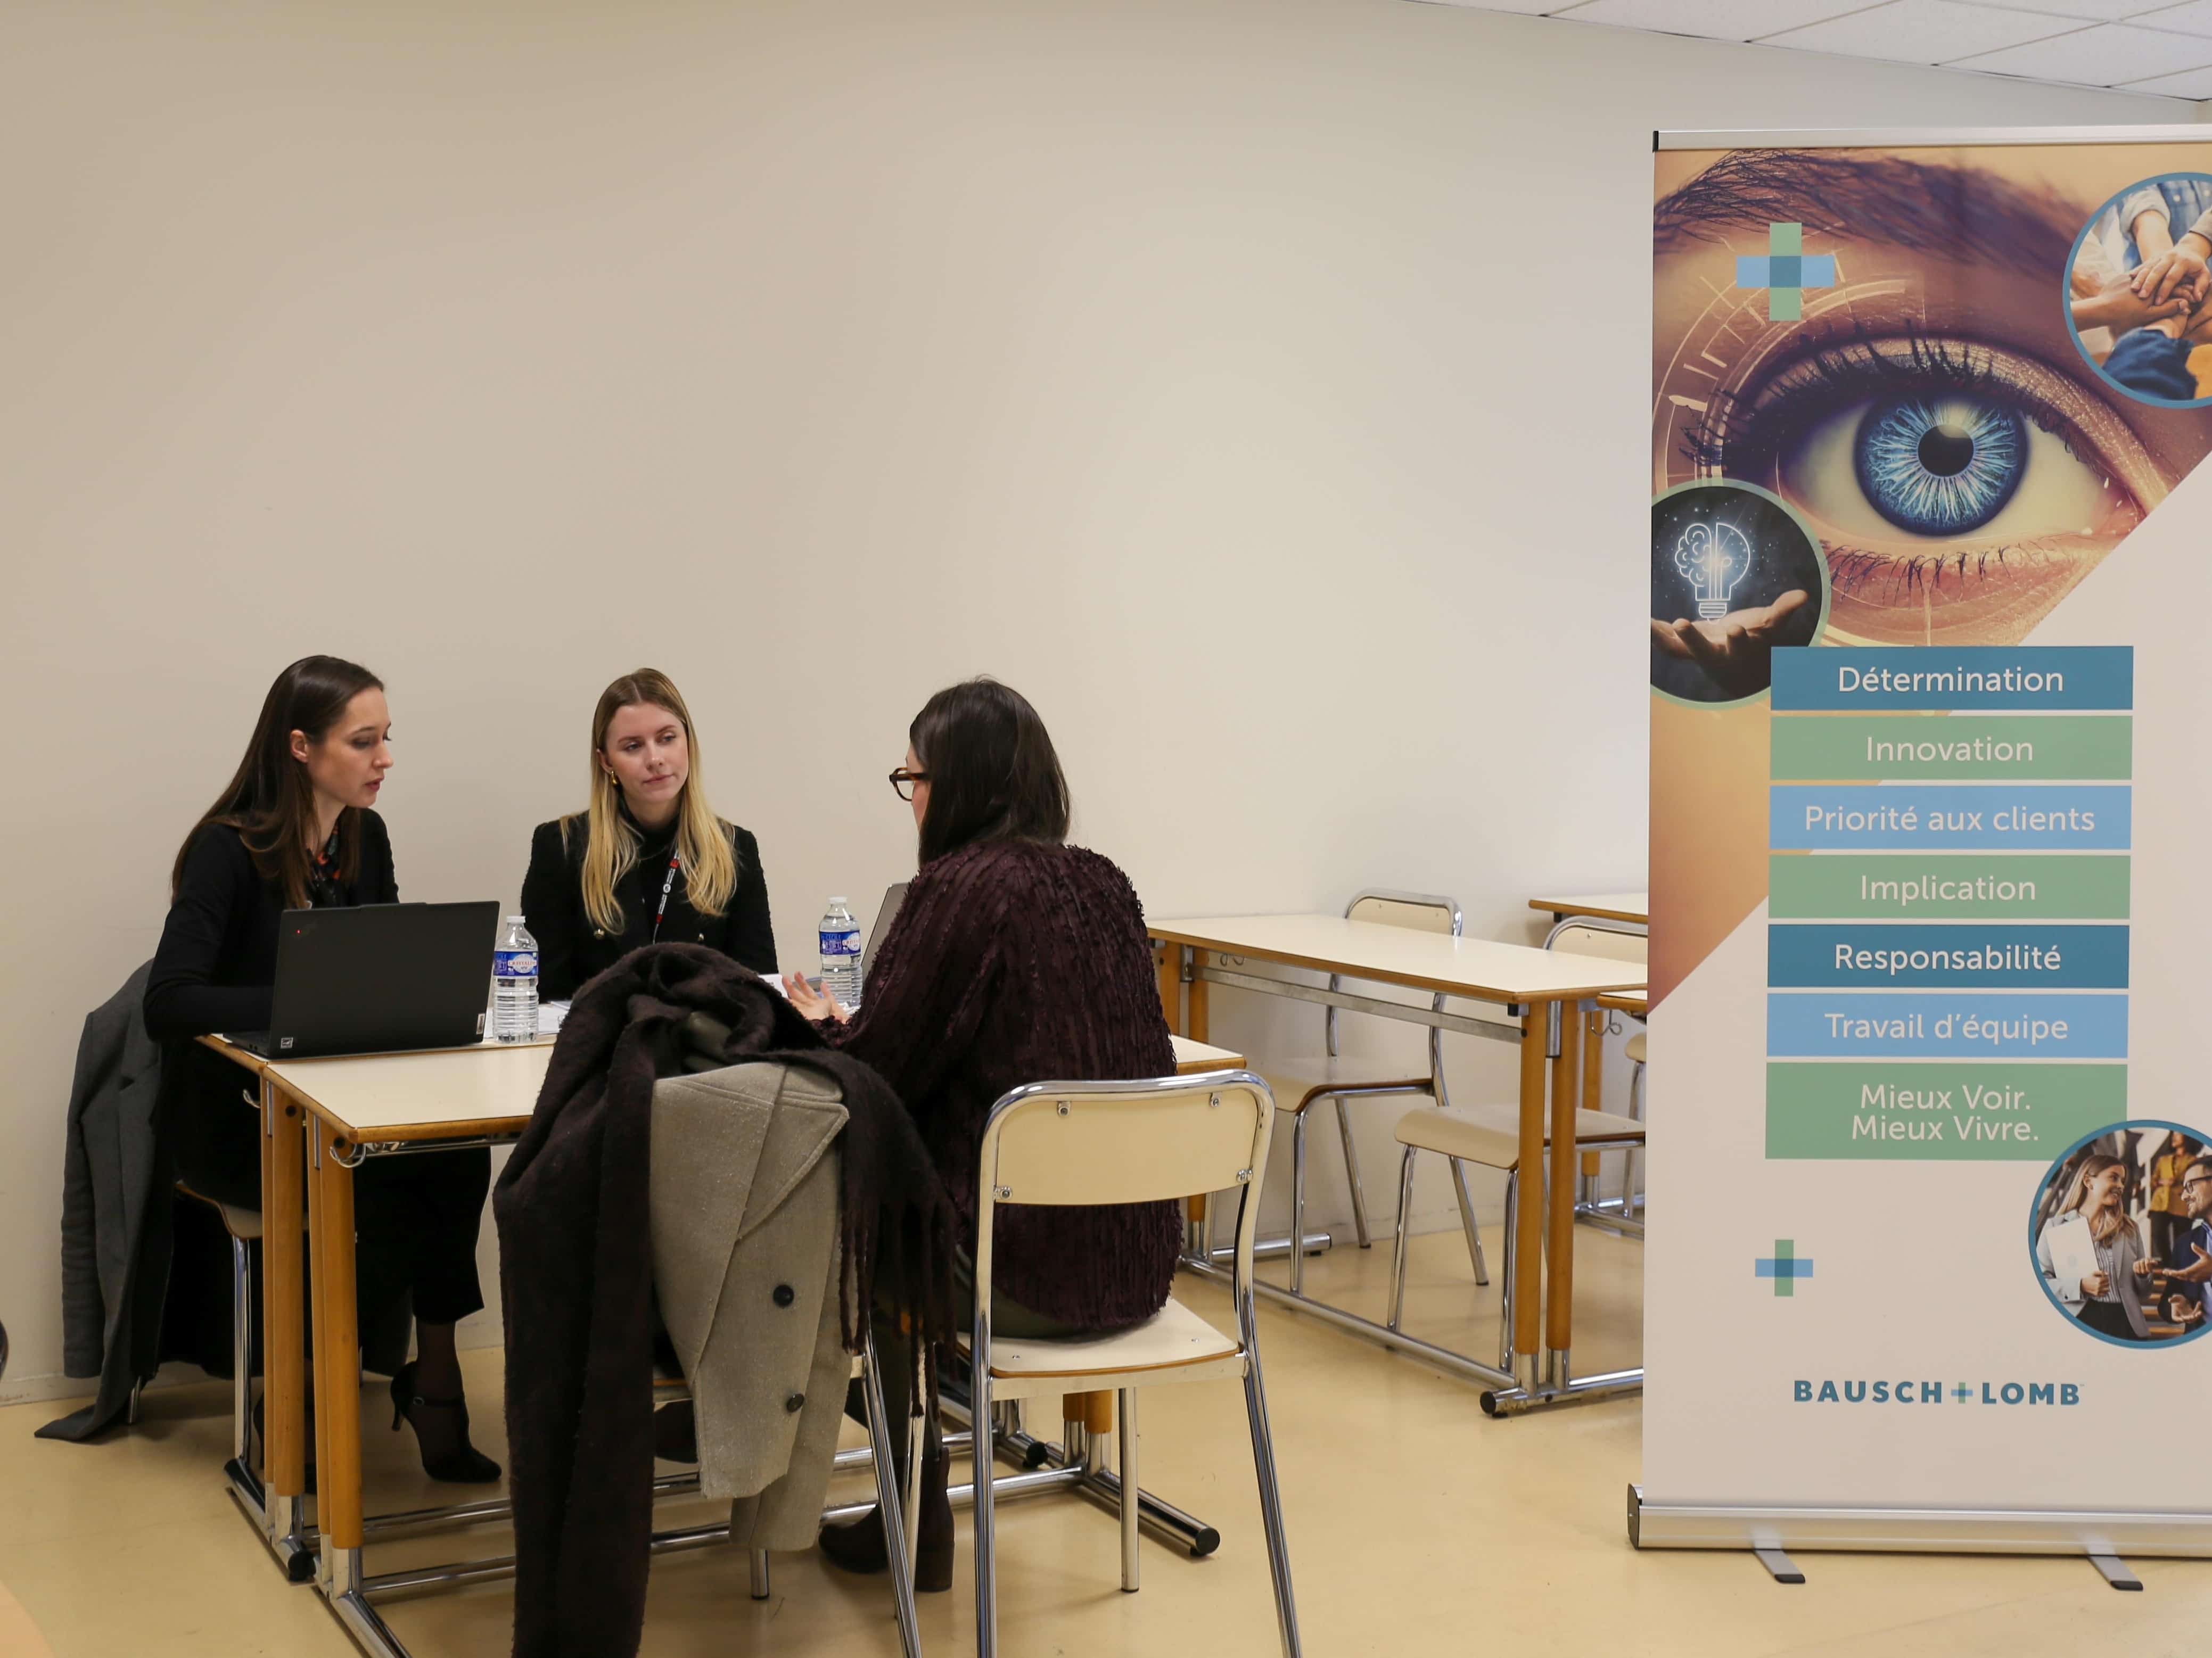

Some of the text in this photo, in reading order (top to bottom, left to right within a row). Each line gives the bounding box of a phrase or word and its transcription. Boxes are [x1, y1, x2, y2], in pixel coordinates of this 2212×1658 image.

[1839, 666, 2063, 692] Détermination
[1867, 736, 2033, 762] Innovation
[1806, 805, 2096, 831] Priorité aux clients
[1861, 875, 2036, 906] Implication
[1835, 944, 2061, 975] Responsabilité
[1824, 1013, 2068, 1045] Travail d'équipe
[1861, 1084, 2030, 1110] Mieux Voir.
[1852, 1115, 2038, 1141] Mieux Vivre.
